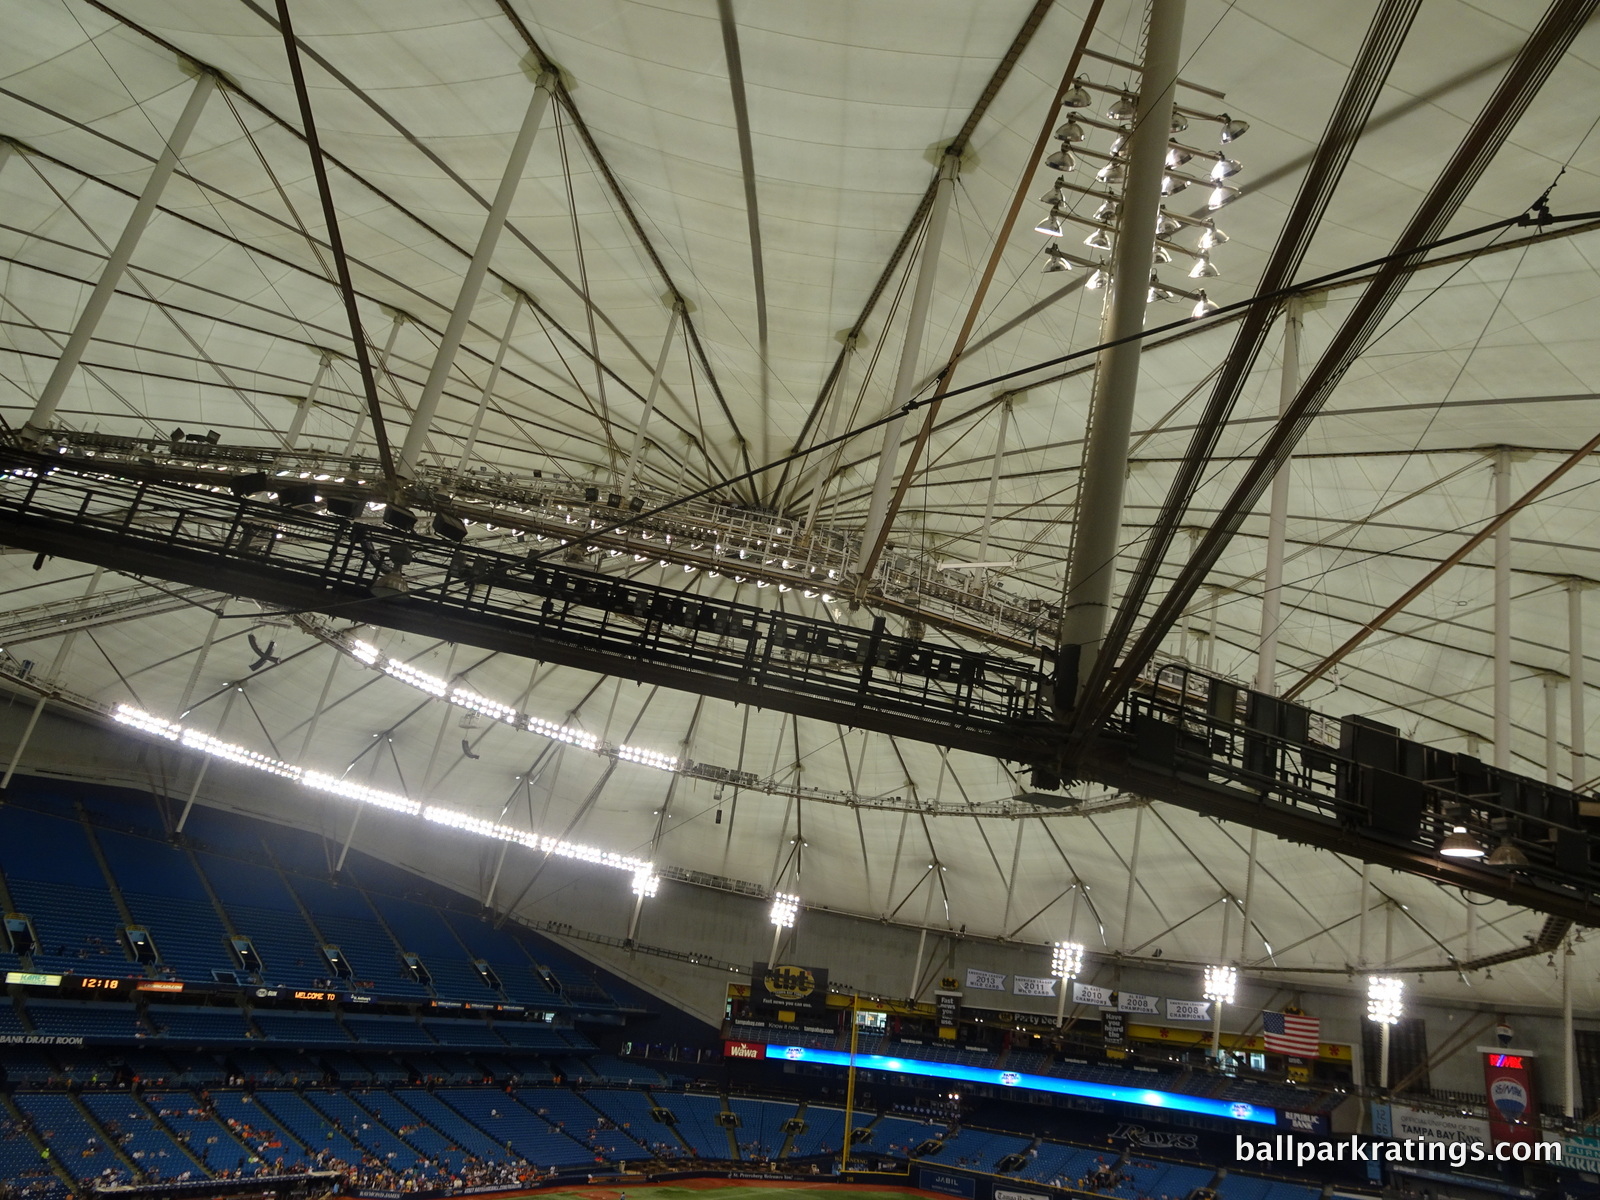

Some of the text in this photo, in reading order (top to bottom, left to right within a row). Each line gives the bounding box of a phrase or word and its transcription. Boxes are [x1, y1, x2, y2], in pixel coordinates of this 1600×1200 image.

[82, 978, 118, 989] 12:18
[976, 976, 995, 984] 2013
[294, 992, 324, 1000] WELCOME
[1082, 990, 1102, 999] 2010
[1076, 996, 1107, 1005] CHAMPIONS
[1127, 998, 1148, 1007] 2008
[1121, 1005, 1154, 1013] CHAMPIONS
[1176, 1006, 1198, 1014] 2008
[1014, 1014, 1040, 1025] Party
[1041, 1016, 1061, 1025] Dec
[735, 1019, 764, 1027] tampabay.com
[804, 1026, 834, 1034] tampabay.com
[26, 1036, 54, 1044] DRAFT
[56, 1037, 83, 1045] ROOM
[731, 1046, 758, 1058] Wawa
[1285, 1111, 1320, 1124] REPUBLIC
[1376, 1109, 1386, 1119] 12
[1292, 1120, 1313, 1130] BANK
[1376, 1124, 1388, 1135] 66
[1108, 1122, 1198, 1149] RAYS
[1401, 1125, 1434, 1137] TAMPA
[1436, 1130, 1456, 1140] BAY
[936, 1176, 959, 1186] JABIL
